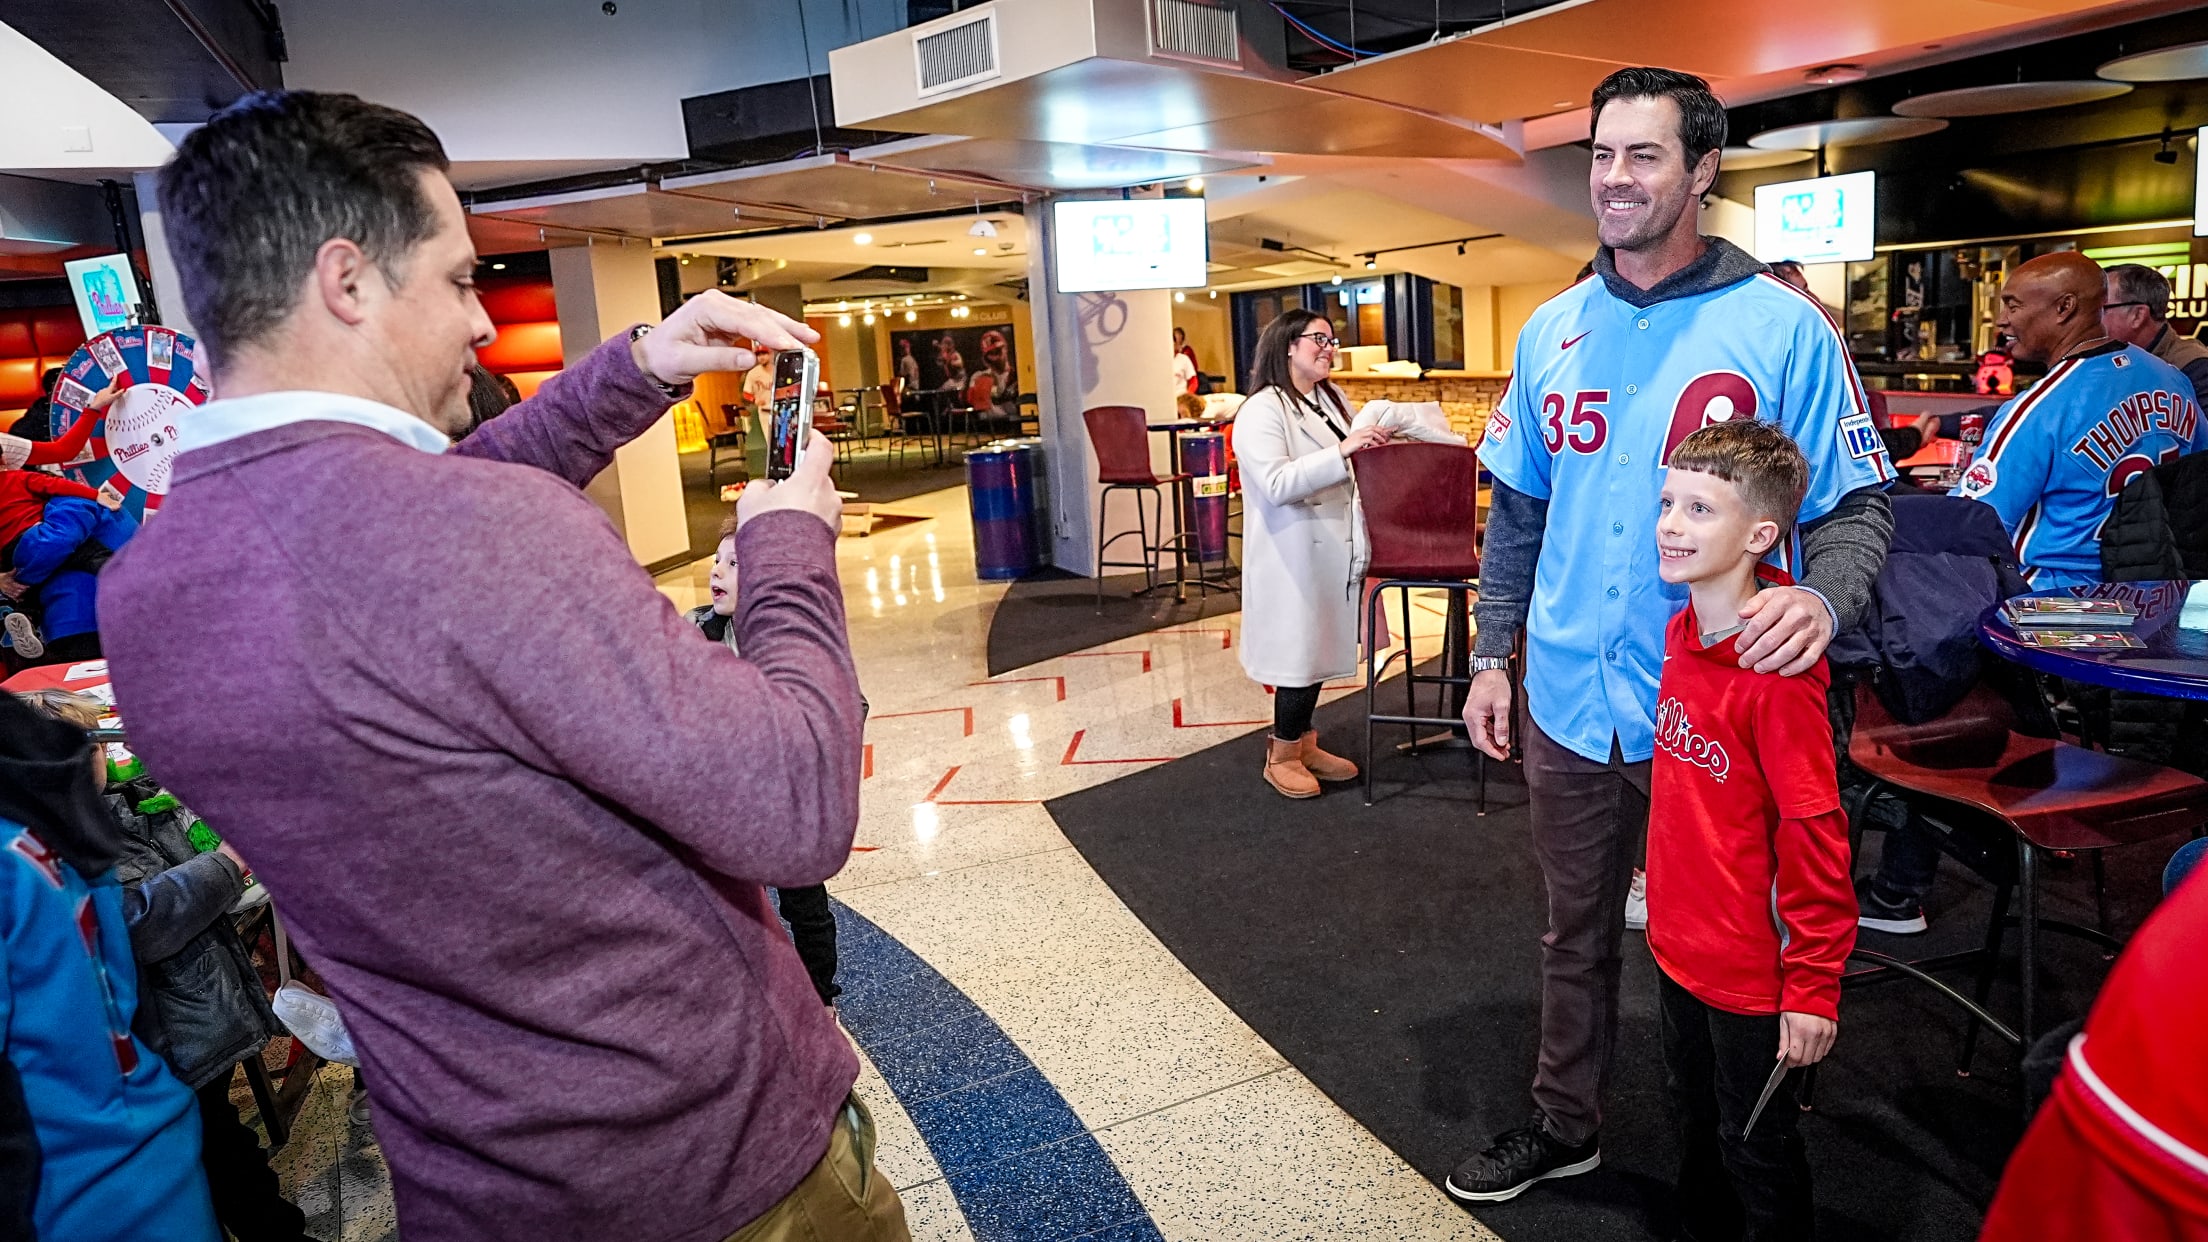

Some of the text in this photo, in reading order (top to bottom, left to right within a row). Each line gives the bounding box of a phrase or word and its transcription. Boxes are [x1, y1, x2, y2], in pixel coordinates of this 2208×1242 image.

[114, 442, 150, 464] Phillies
[1542, 388, 1611, 456] 35
[2071, 390, 2197, 473] THOMPSON
[1655, 697, 1730, 777] illies
